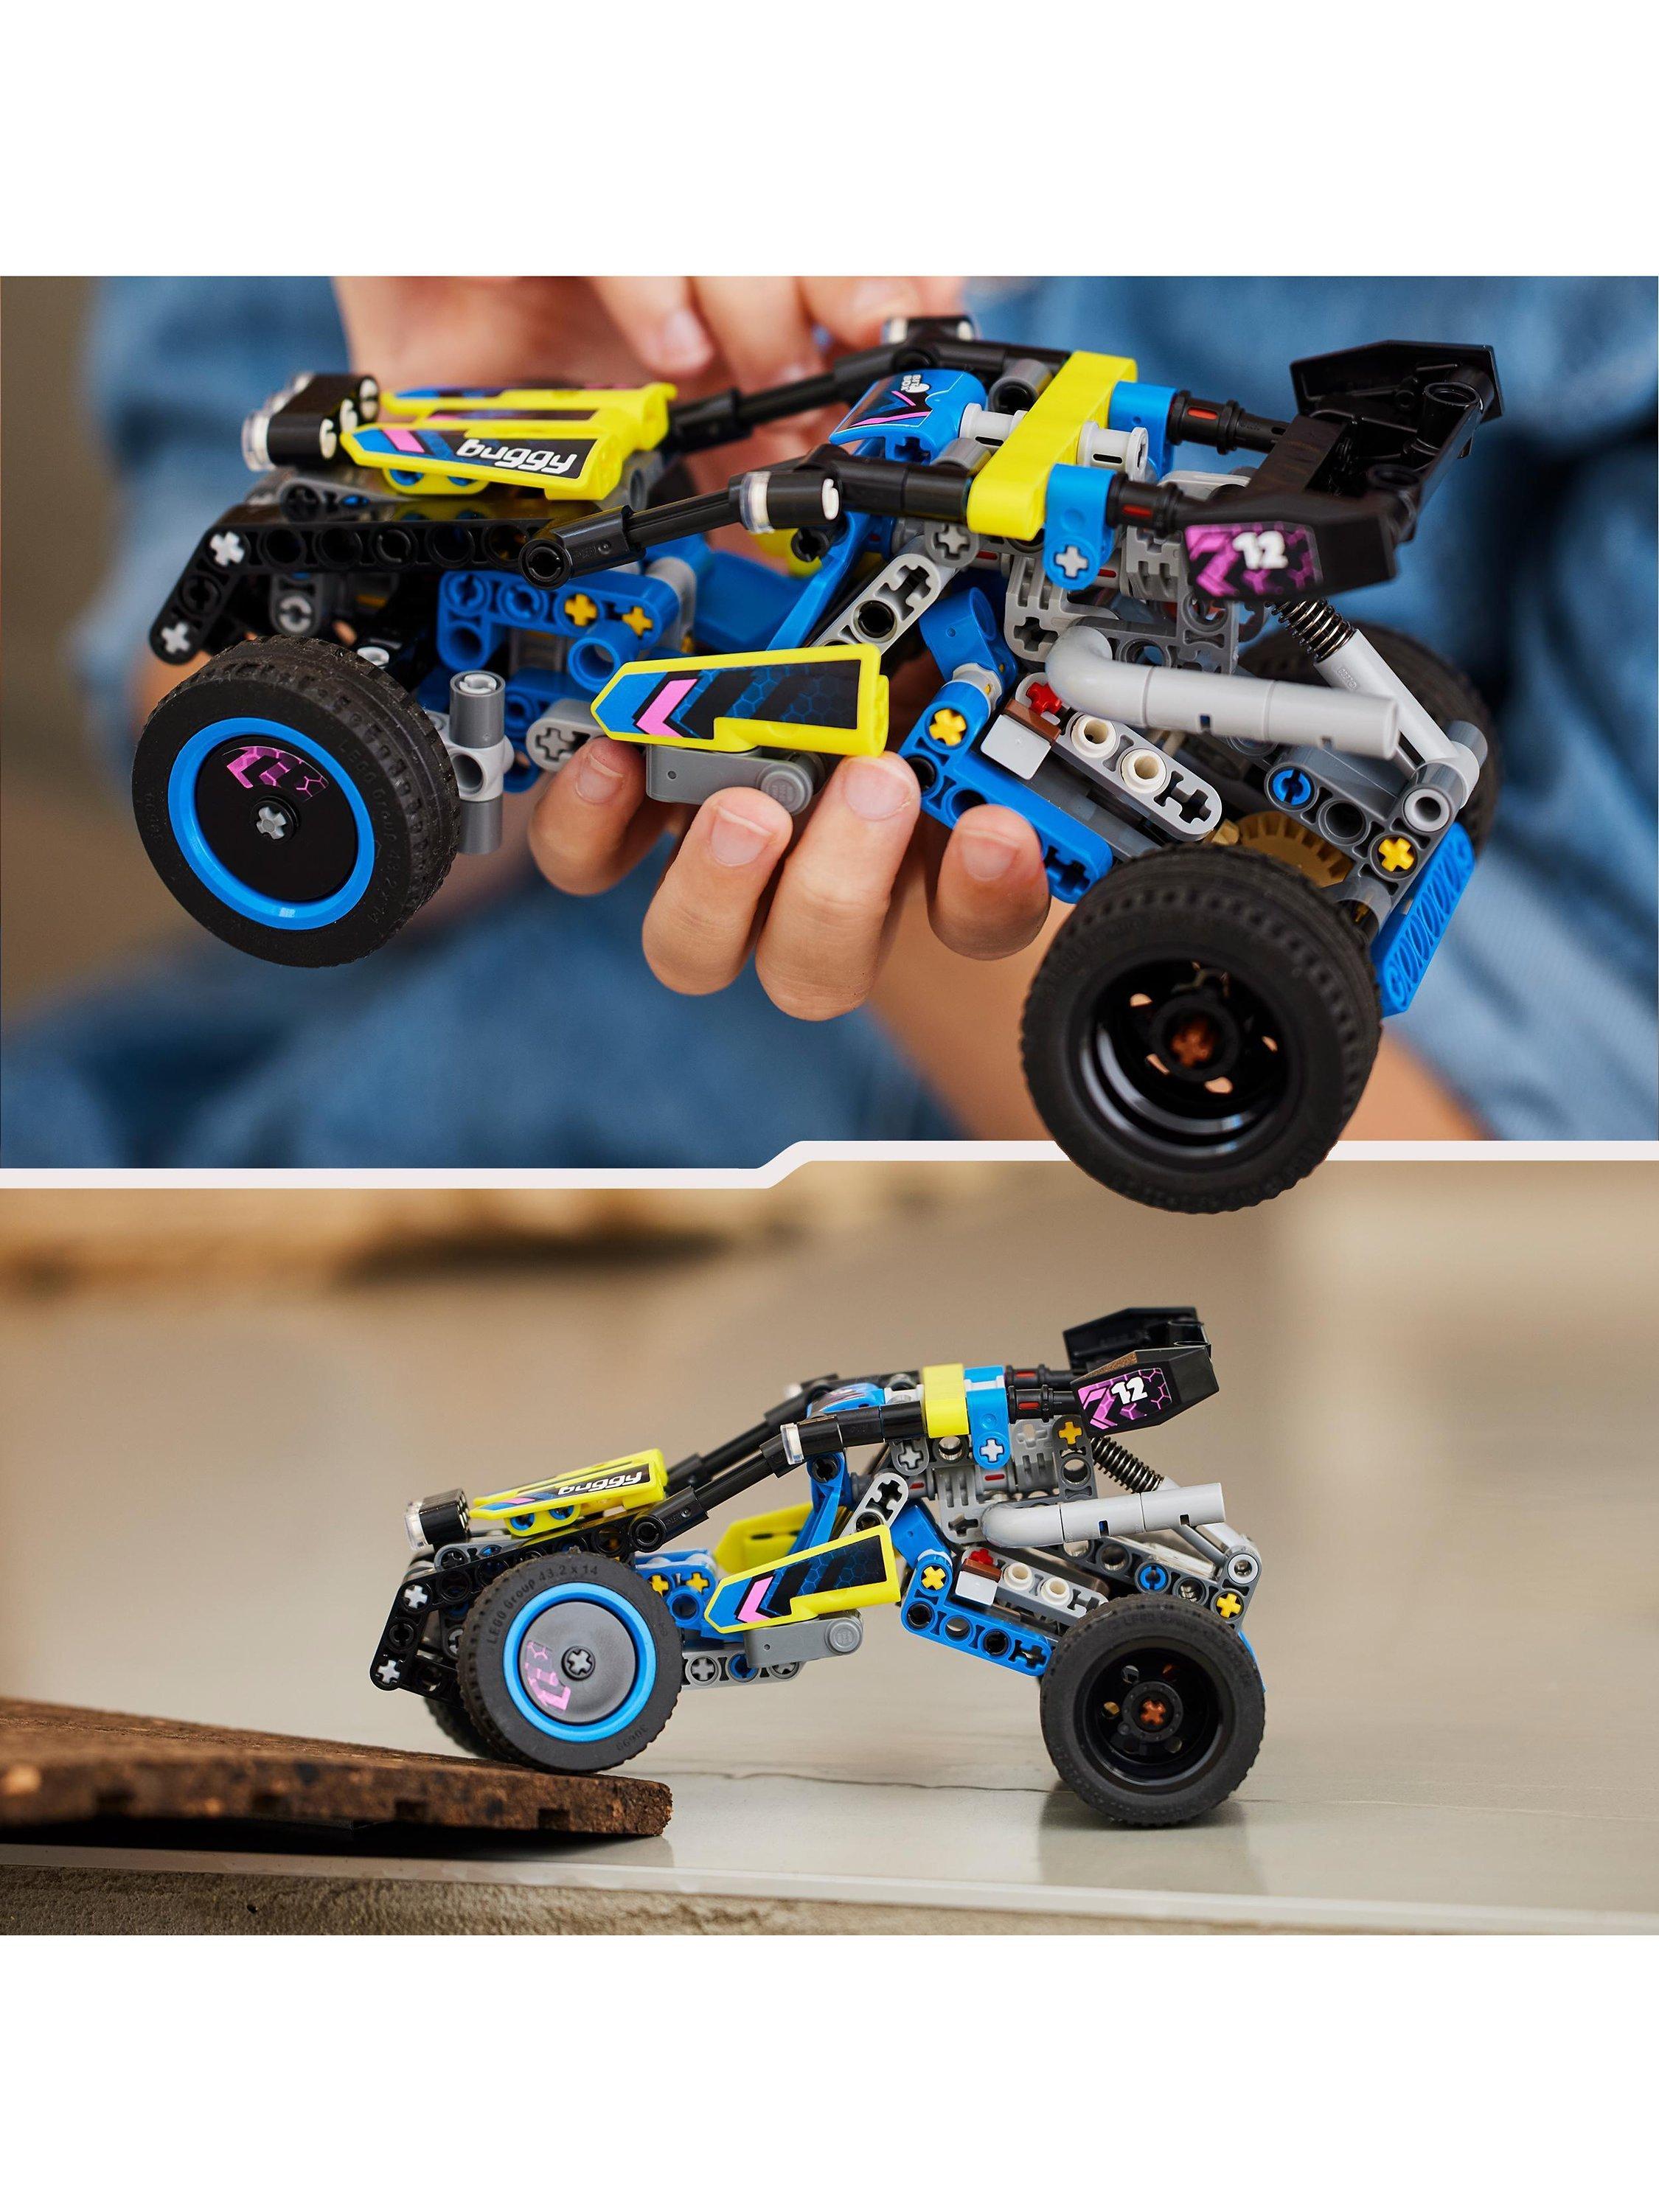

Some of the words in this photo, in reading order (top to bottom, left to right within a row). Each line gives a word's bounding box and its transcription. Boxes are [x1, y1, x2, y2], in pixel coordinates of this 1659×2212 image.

[456, 439, 577, 474] buggy
[1232, 530, 1289, 569] 12
[1111, 1377, 1147, 1405] 12
[557, 1471, 642, 1495] buggy
[487, 1610, 507, 1644] LEGO
[504, 1579, 536, 1609] Group
[538, 1565, 567, 1581] 43.2
[582, 1564, 598, 1576] 14
